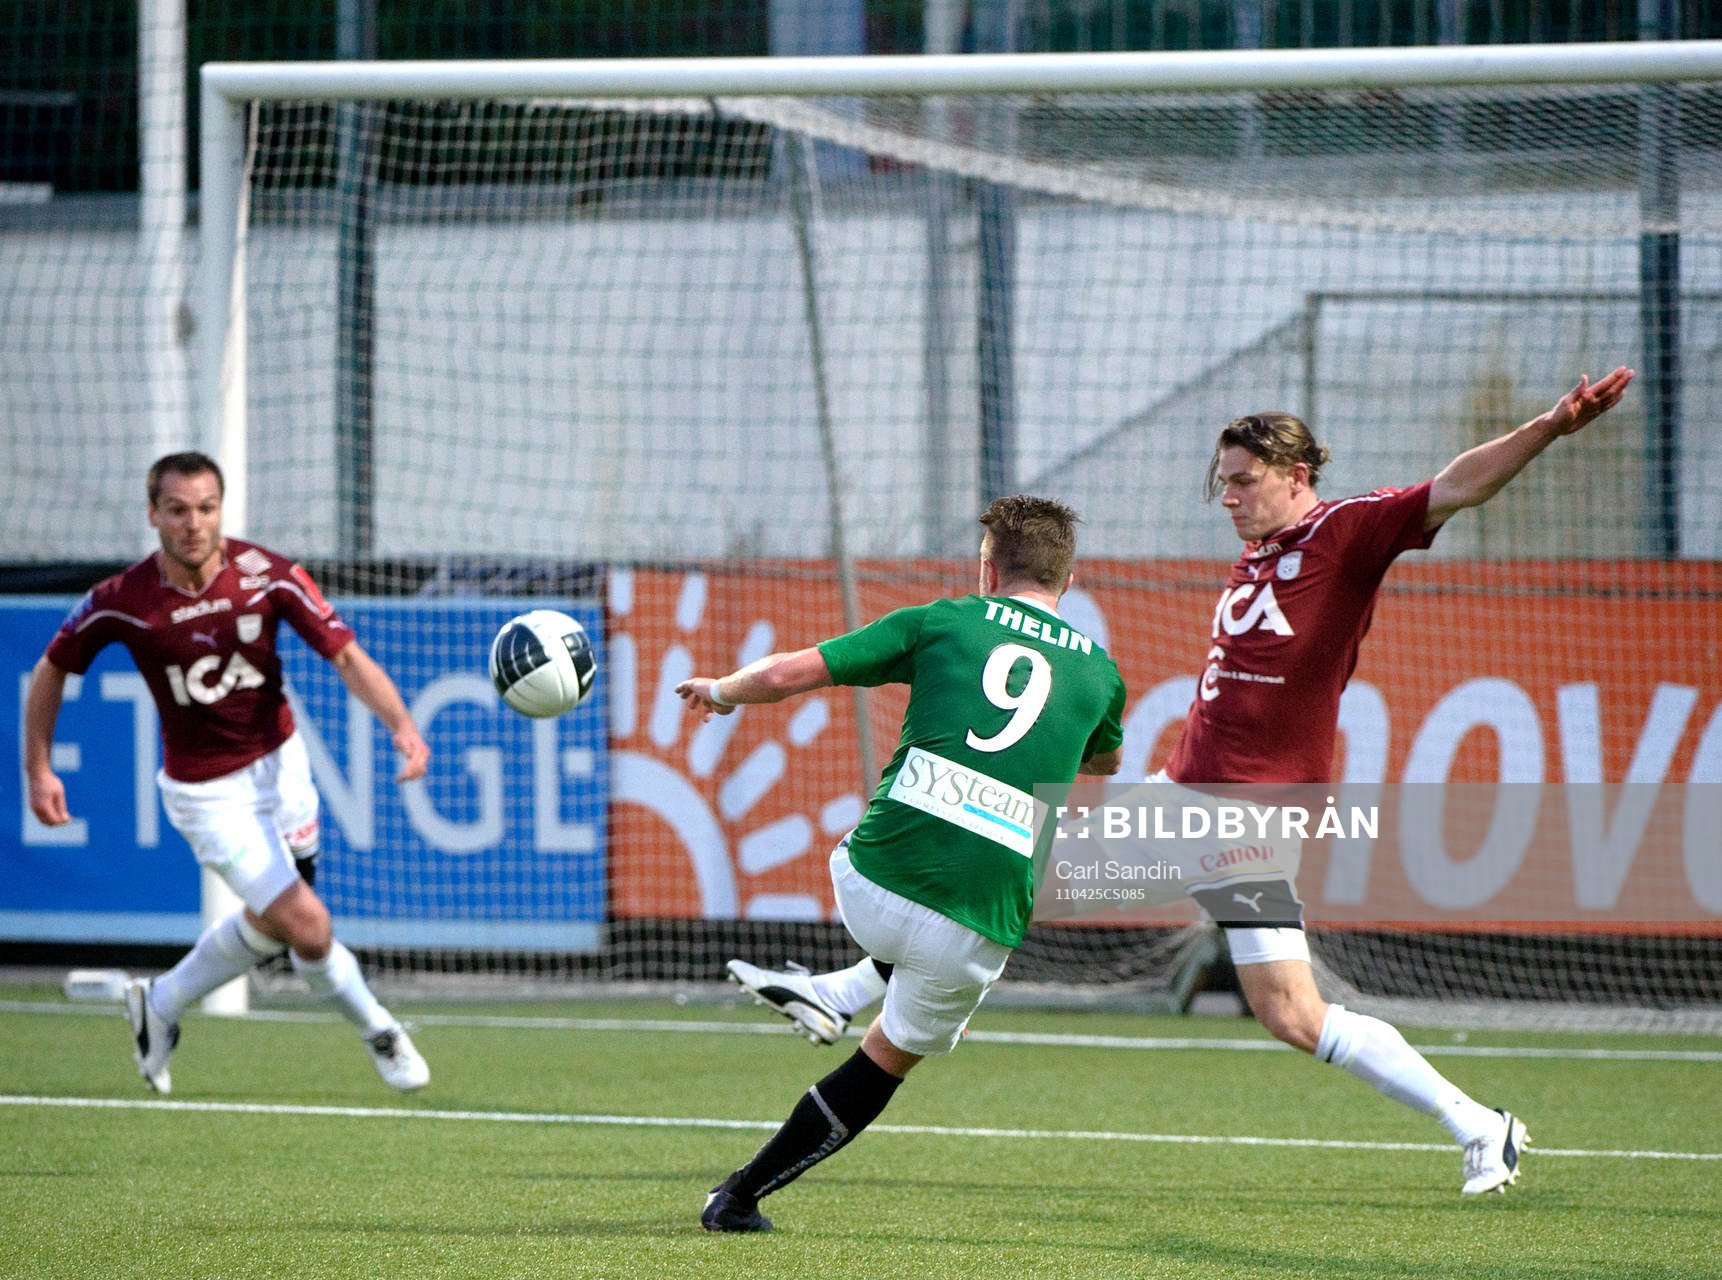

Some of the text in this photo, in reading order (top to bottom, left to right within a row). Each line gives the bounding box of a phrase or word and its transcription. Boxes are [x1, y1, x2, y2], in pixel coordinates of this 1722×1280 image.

[984, 600, 1093, 656] THELIN
[1212, 582, 1295, 639] ICA
[165, 651, 266, 706] ICA
[965, 643, 1052, 753] 9
[20, 670, 597, 855] ETNGE
[899, 754, 1038, 832] SYSteam
